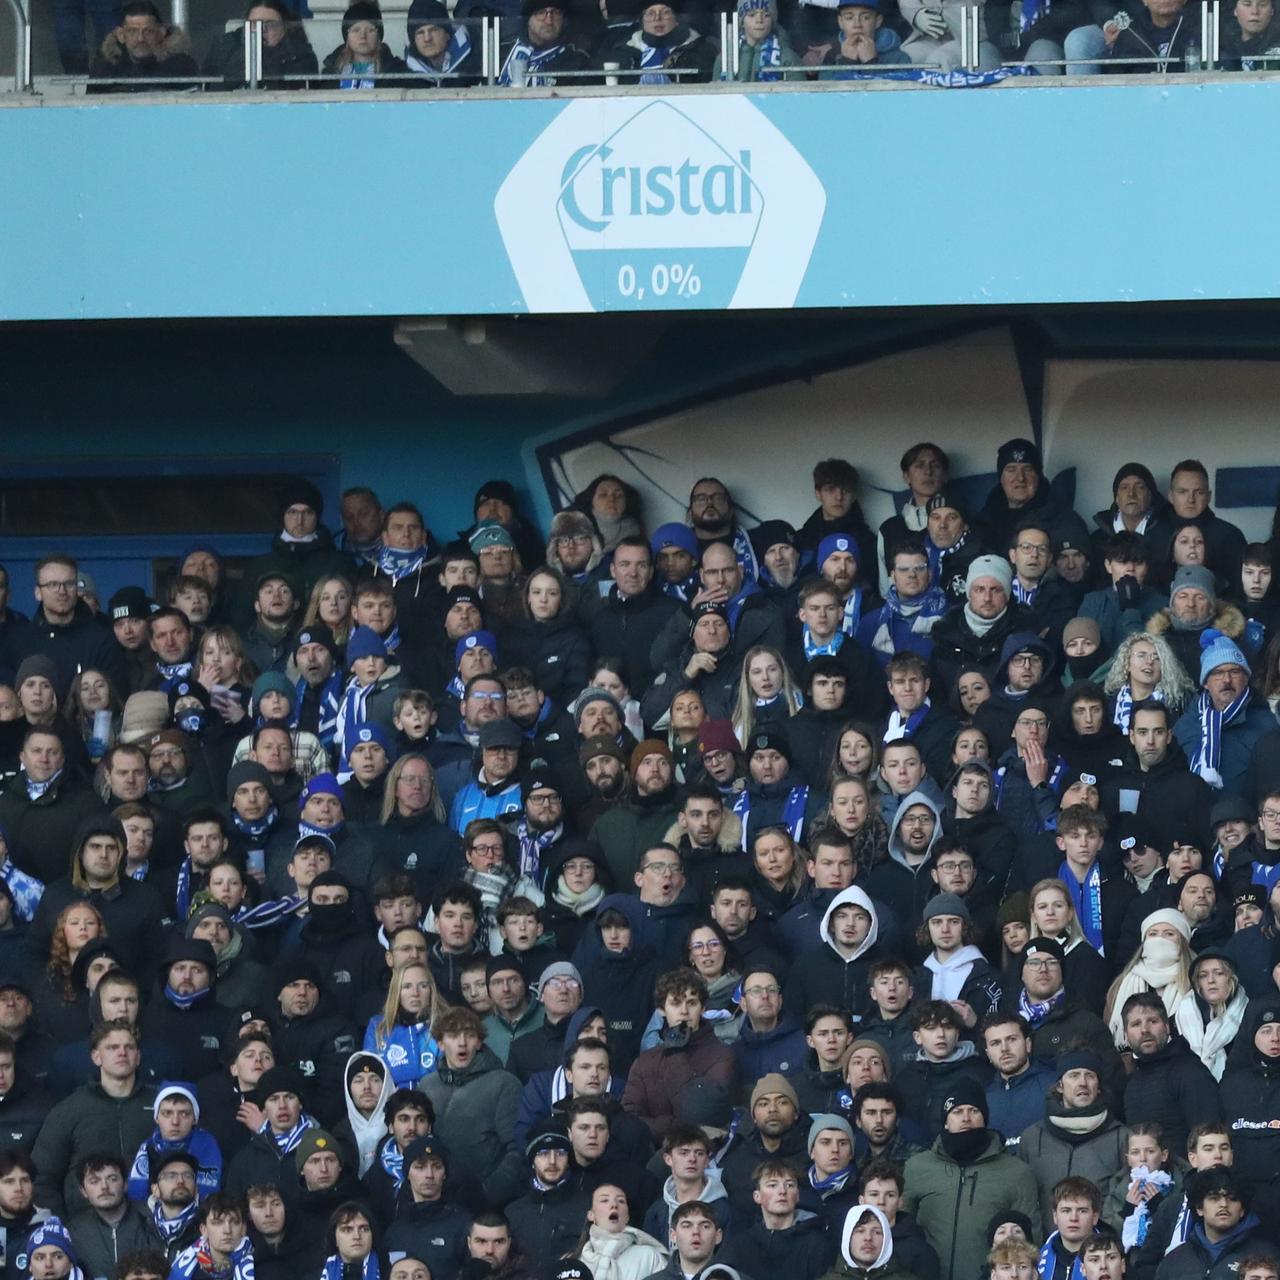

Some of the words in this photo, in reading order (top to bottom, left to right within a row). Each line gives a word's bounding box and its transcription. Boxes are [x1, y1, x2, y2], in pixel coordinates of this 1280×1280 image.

[560, 143, 753, 233] Cristal
[618, 263, 702, 301] 0,0%
[1232, 1118, 1269, 1130] ellesse
